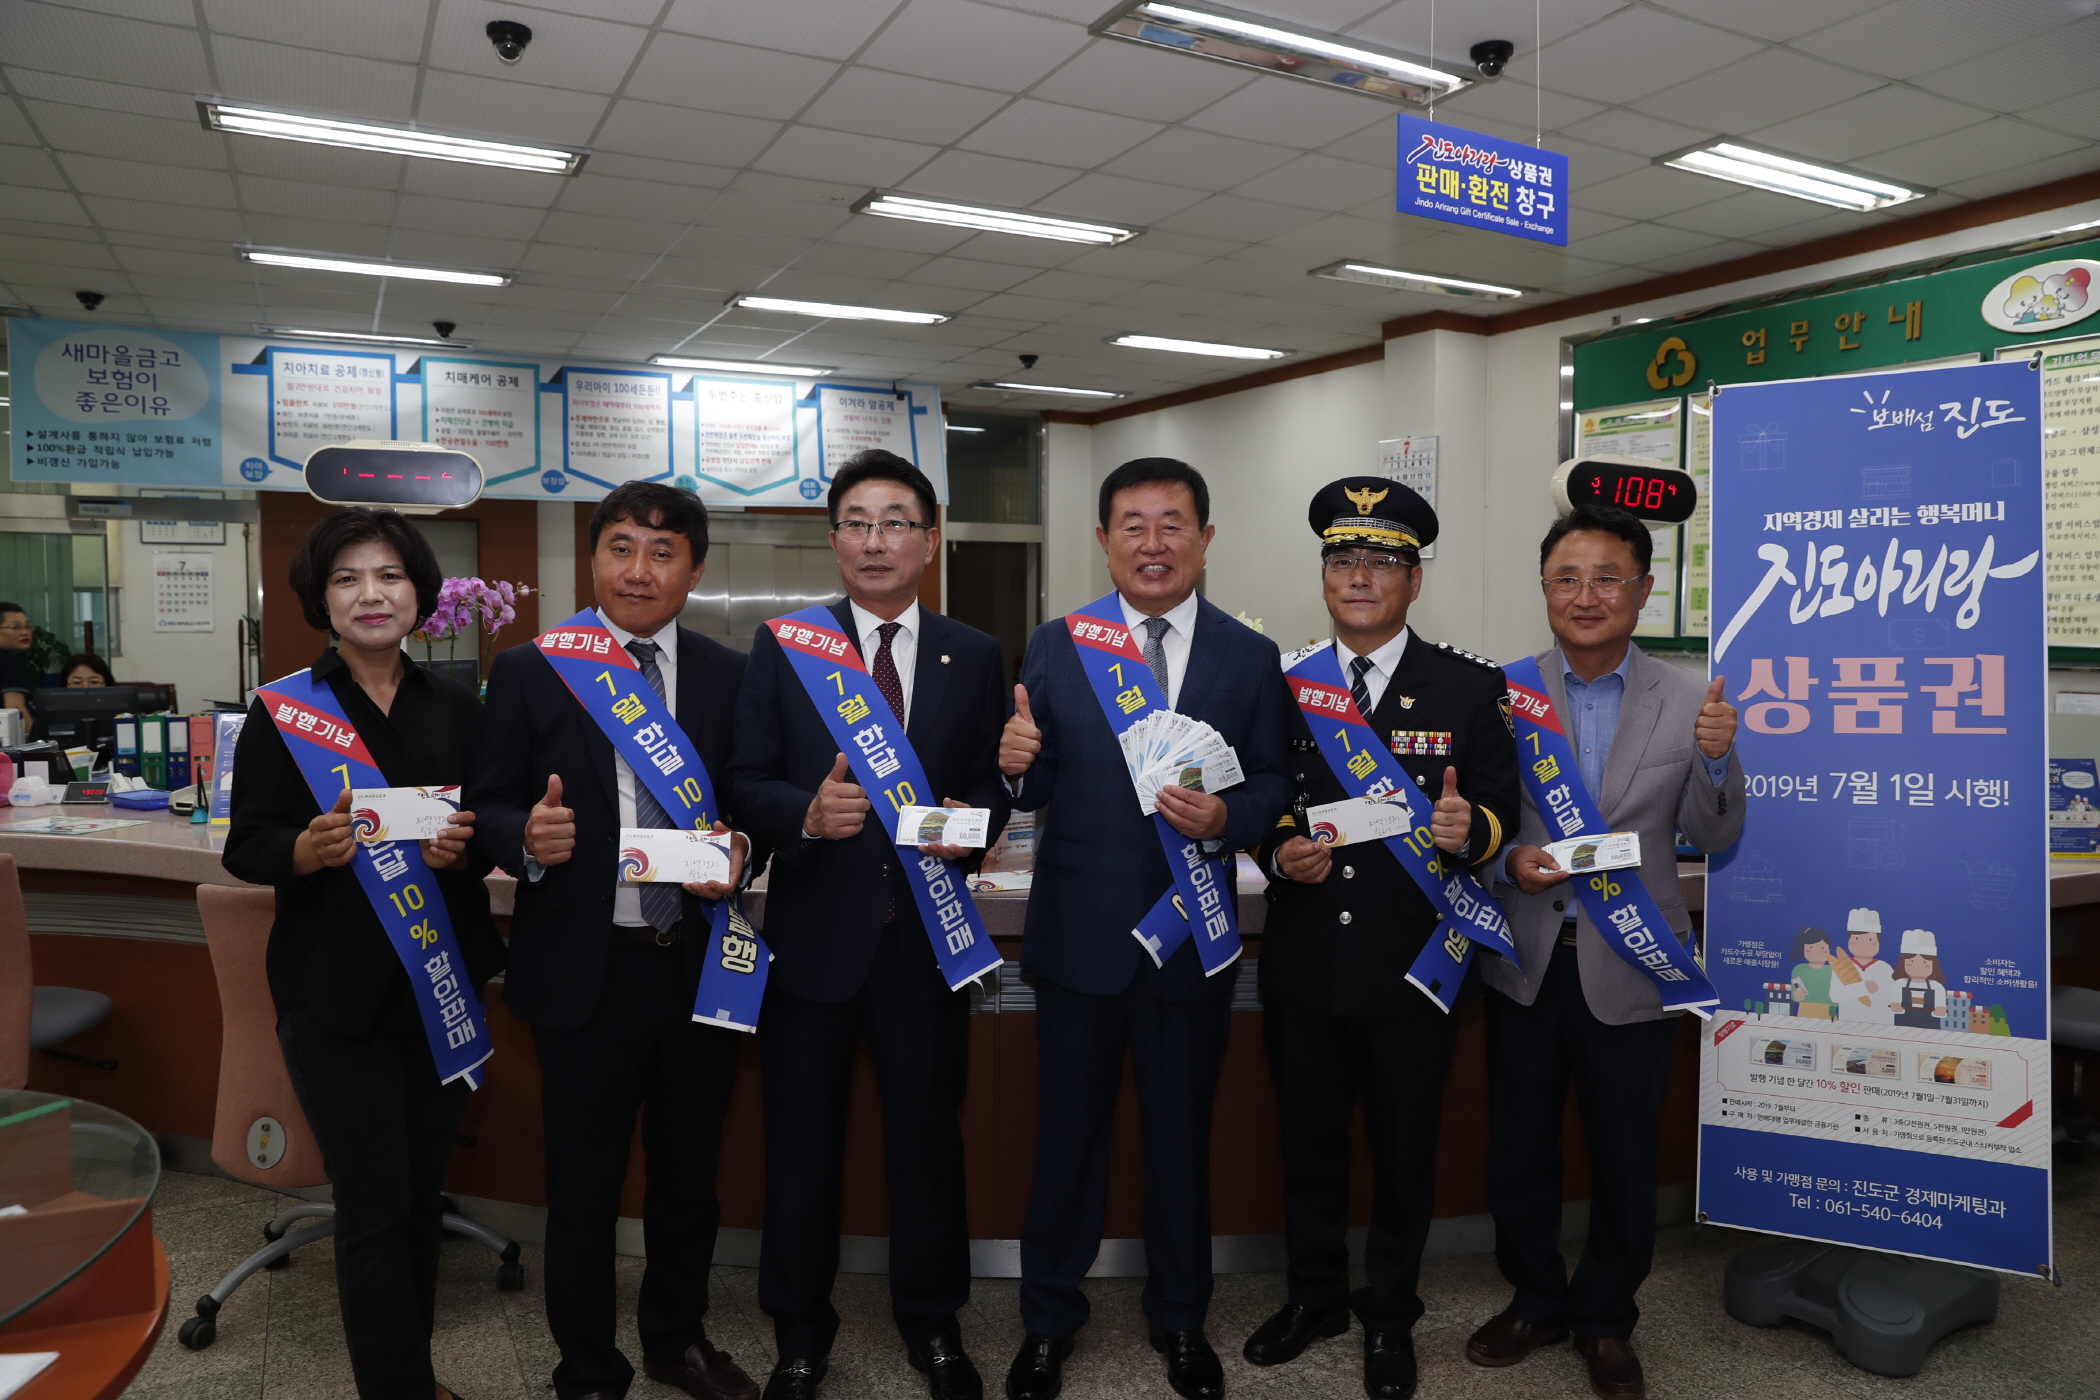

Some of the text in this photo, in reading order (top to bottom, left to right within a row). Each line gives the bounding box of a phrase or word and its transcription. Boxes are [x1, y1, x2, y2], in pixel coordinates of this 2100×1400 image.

[1407, 134, 1553, 187] 진도아리랑 상품권
[1515, 186, 1555, 220] 창구
[1415, 197, 1554, 235] Jindo Arirang Gift Certificate Sale Exchange
[61, 343, 181, 369] 새마을금고
[86, 368, 157, 393] 보험이
[283, 361, 331, 376] 치아치료
[445, 371, 519, 388] 치매케어 공제
[575, 380, 611, 394] 우리아이
[75, 391, 171, 416] 좋은이유
[840, 397, 895, 411] 이겨라 암공제
[1864, 396, 2026, 439] 보배섬 진도
[37, 429, 212, 447] 설계사를 통하지 않아 보험료 저렴
[1403, 442, 1411, 454] 7
[37, 443, 175, 458] 100%환급 적립식 납입가능
[37, 457, 121, 469] 비갱신 가입가능
[1614, 477, 1665, 509] 108
[1763, 500, 2005, 532] 지역경제 살리는 행복머니
[179, 561, 186, 571] 7
[1714, 535, 2039, 664] 진도아리랑
[541, 631, 612, 654] 발행기념
[777, 623, 849, 657] 발행기념
[1072, 620, 1129, 648] 발행기념
[1298, 686, 1351, 713] 발행기념
[1737, 653, 2007, 735] 상품권
[275, 703, 357, 748] 발행기념
[1744, 771, 2010, 808] 2019년 7월 1일 시행!
[1608, 903, 1690, 984] 할인판매
[1720, 948, 1753, 957] 카드수수료
[1738, 940, 1765, 949] 가맹점은
[1980, 967, 2021, 977] 할인 혜택과
[1984, 958, 2016, 968] 소비자는
[1963, 975, 2038, 988] 합리적인 소비생활을!
[424, 950, 476, 1050] 할인판매
[1718, 1022, 1737, 1038] 발행기념
[1750, 1073, 1767, 1083] 발행
[1768, 1074, 1785, 1085] 기념
[1787, 1075, 1796, 1086] 한
[1797, 1078, 1814, 1089] 달간
[1816, 1079, 1837, 1090] 10%
[1839, 1081, 1861, 1095] 할인
[1729, 1098, 1753, 1107] 판매시작
[1814, 1120, 1839, 1130] 금융기관
[1893, 1131, 1924, 1141] 가맹점으로
[1926, 1135, 1945, 1144] 등록된
[1947, 1137, 1972, 1147] 진도군내
[2008, 1146, 2022, 1154] 업소
[1734, 1166, 2007, 1219] 사용 및 가맹점 문의 진도군 경제마케팅과
[1789, 1193, 1943, 1230] Tel 061-540-6404
